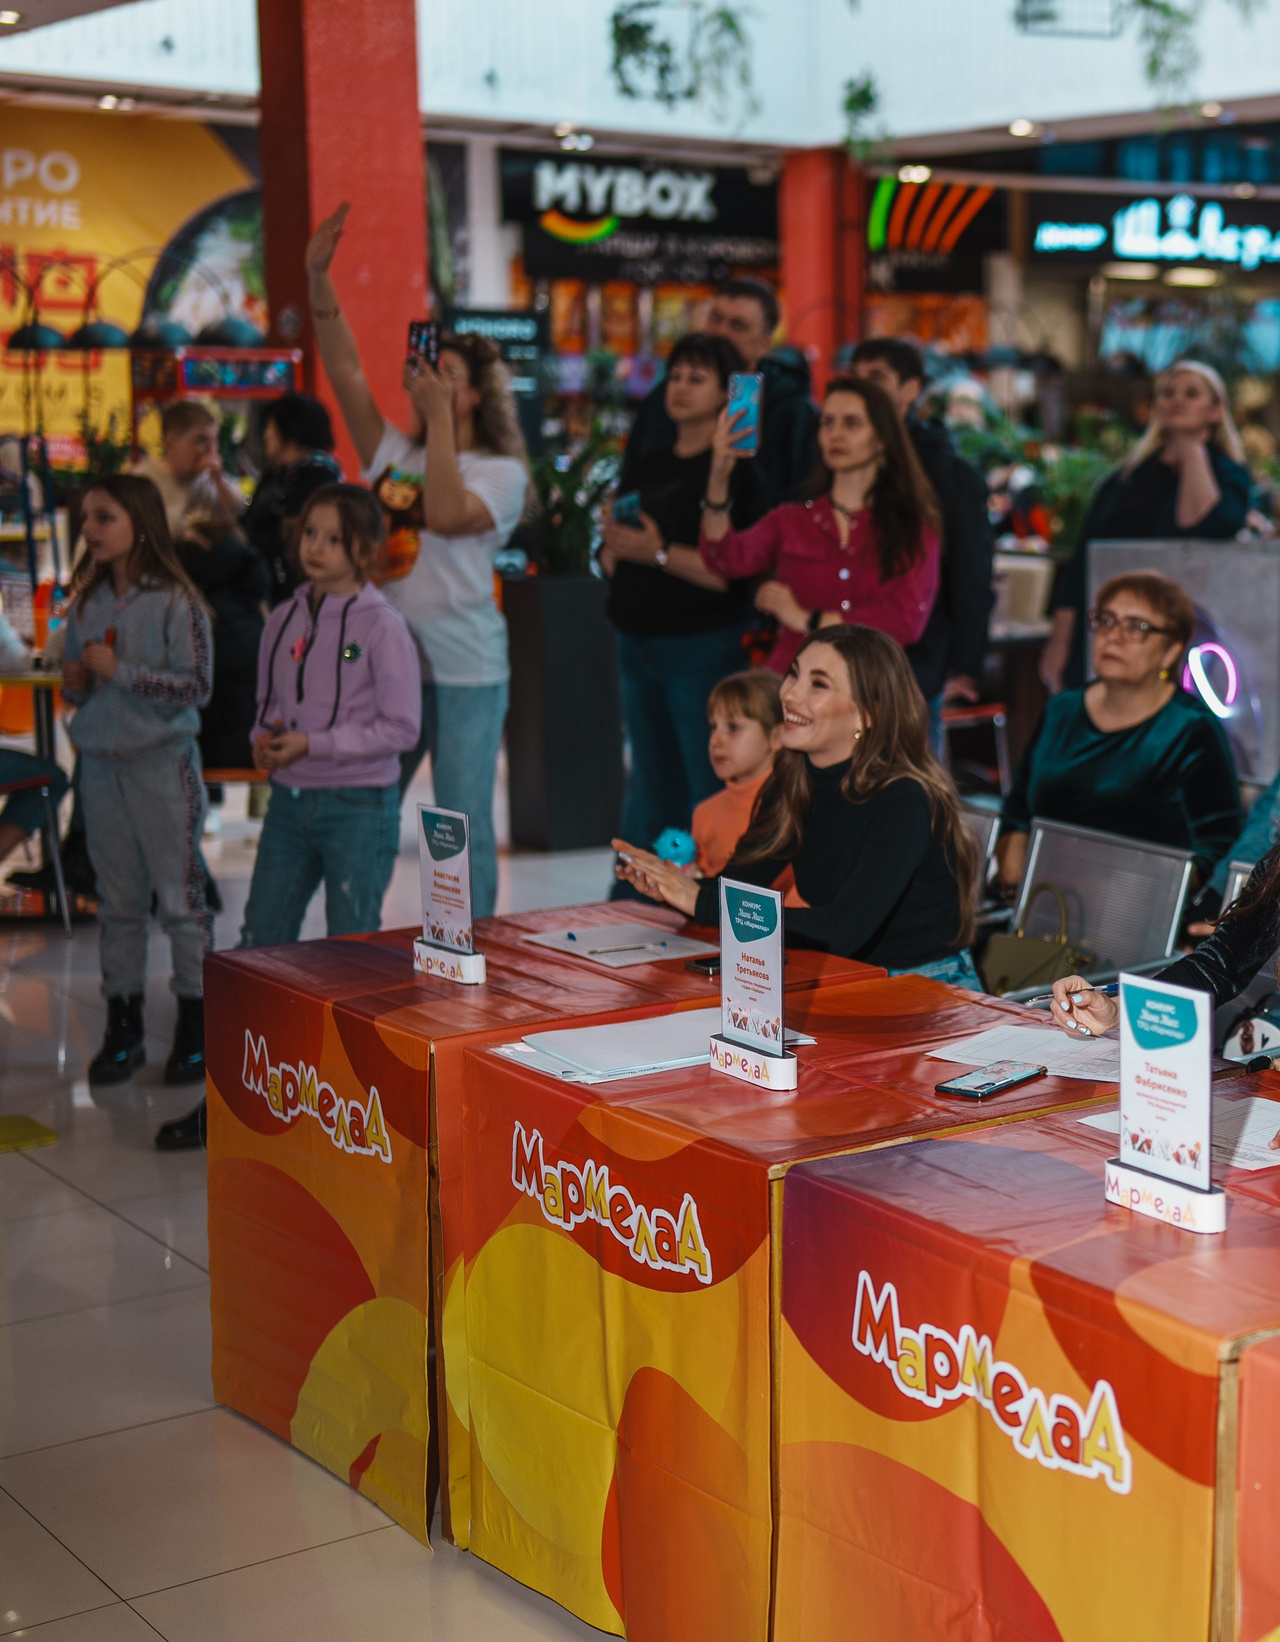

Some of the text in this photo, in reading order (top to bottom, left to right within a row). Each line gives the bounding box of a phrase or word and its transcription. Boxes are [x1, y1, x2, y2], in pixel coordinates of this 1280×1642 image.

[533, 160, 718, 223] MYBOX
[741, 900, 762, 911] КОНКУРС
[735, 917, 744, 926] ТРЦ
[738, 908, 765, 923] Мини Мисс
[741, 952, 765, 967] Наталья
[736, 963, 770, 981] Третьякова
[1144, 1062, 1178, 1080] Татьяна
[1135, 1075, 1187, 1098] Фабрисенко
